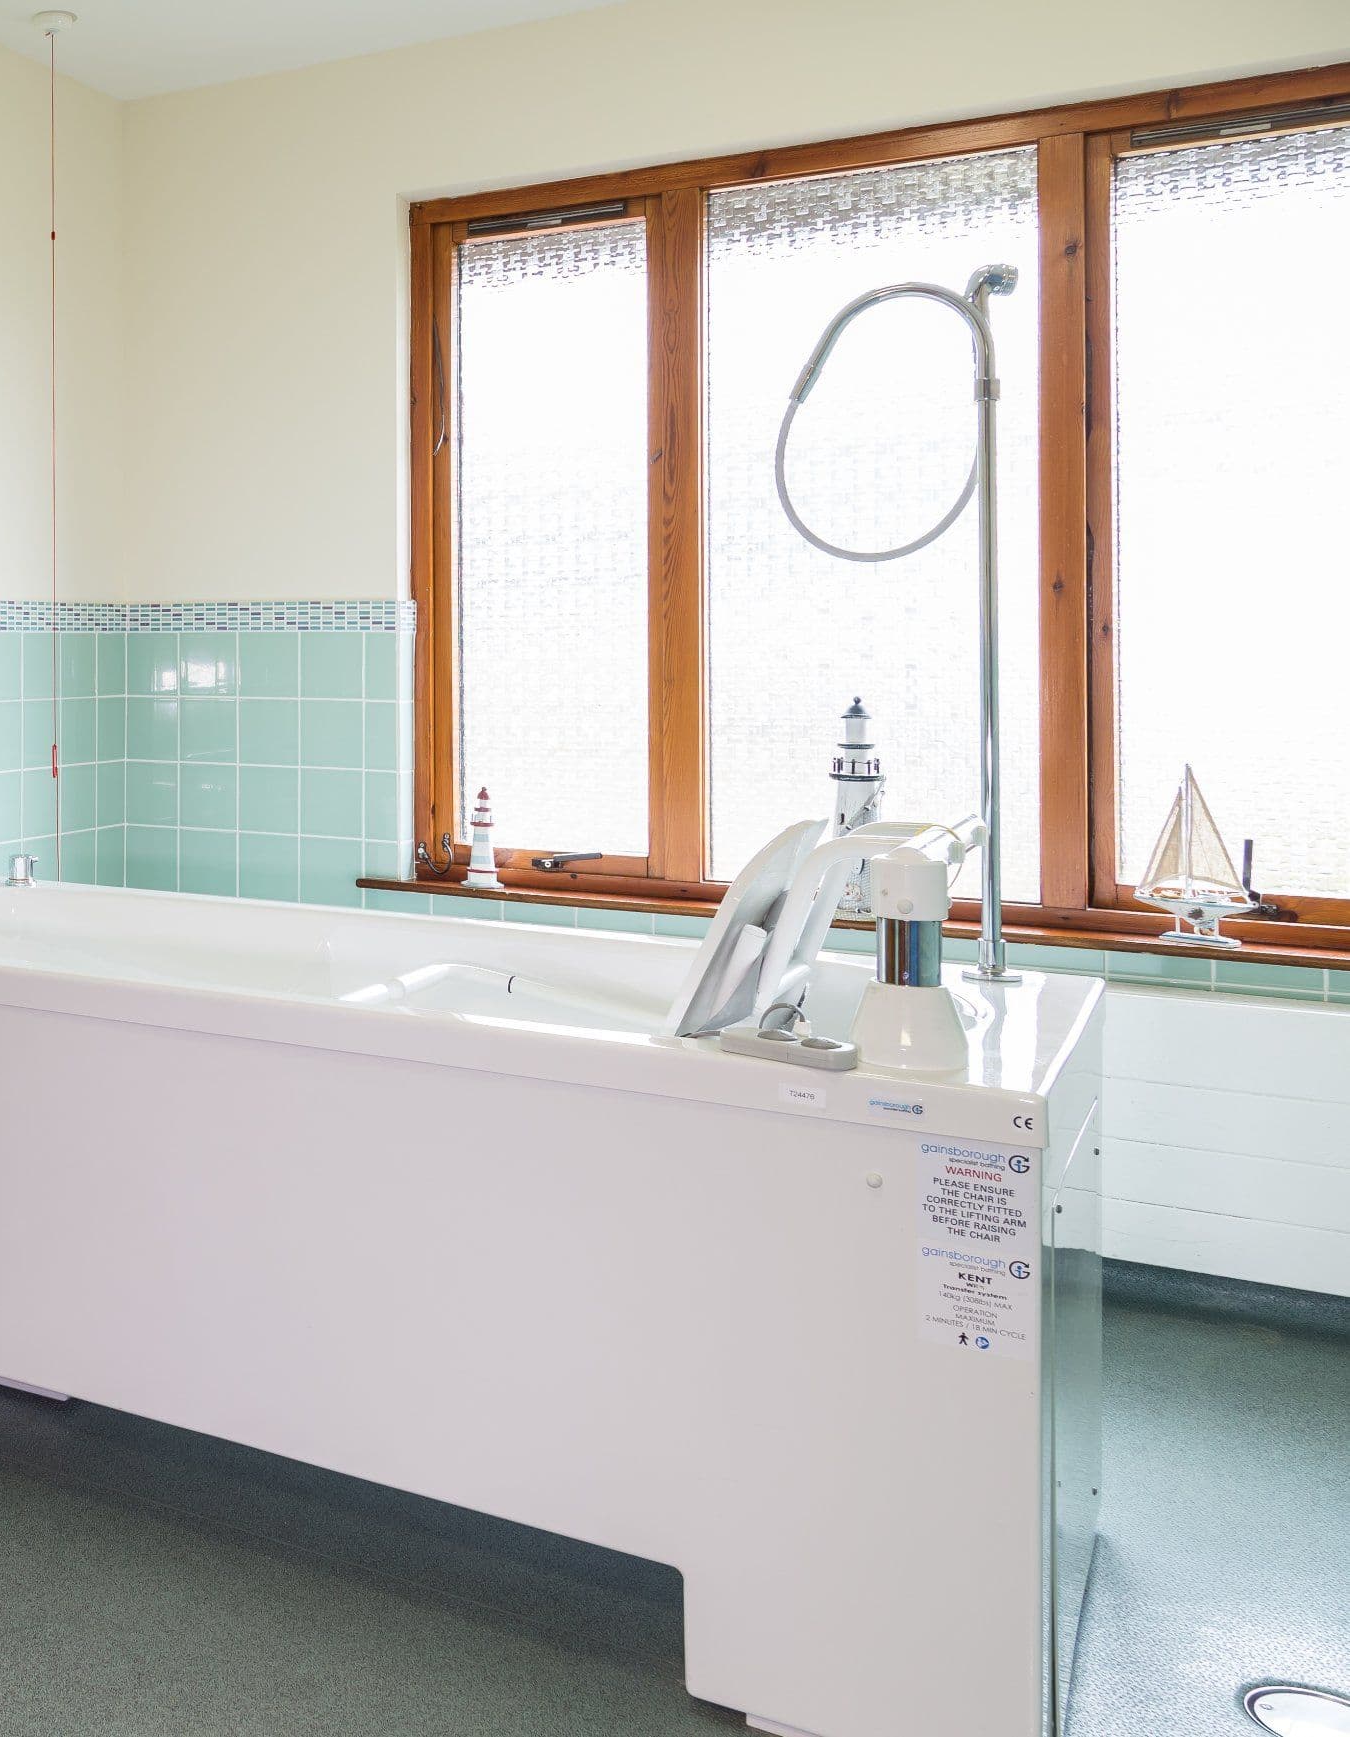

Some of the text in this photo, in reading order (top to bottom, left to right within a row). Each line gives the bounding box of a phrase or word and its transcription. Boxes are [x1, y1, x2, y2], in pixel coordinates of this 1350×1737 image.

[921, 1144, 1006, 1163] gainsborough
[945, 1166, 1002, 1182] WARNING
[933, 1177, 1015, 1197] PLEASE ENSURE
[941, 1187, 1007, 1205] THE CHAIR IS
[922, 1203, 1026, 1228] TO THE LIFTING ARM
[926, 1195, 1022, 1218] CORRECTLY FITTED
[932, 1215, 1016, 1236] BEFORE RAISING
[947, 1227, 1001, 1242] THE CHAIR
[921, 1247, 1006, 1269] gainsborough
[958, 1272, 992, 1285] KENT
[953, 1305, 998, 1319] OPERATION
[994, 1301, 1013, 1311] MAX
[932, 1316, 964, 1328] MINUTES
[982, 1326, 998, 1335] MIN
[999, 1329, 1026, 1341] CYCLE
[955, 1313, 996, 1326] MAXIMUM
